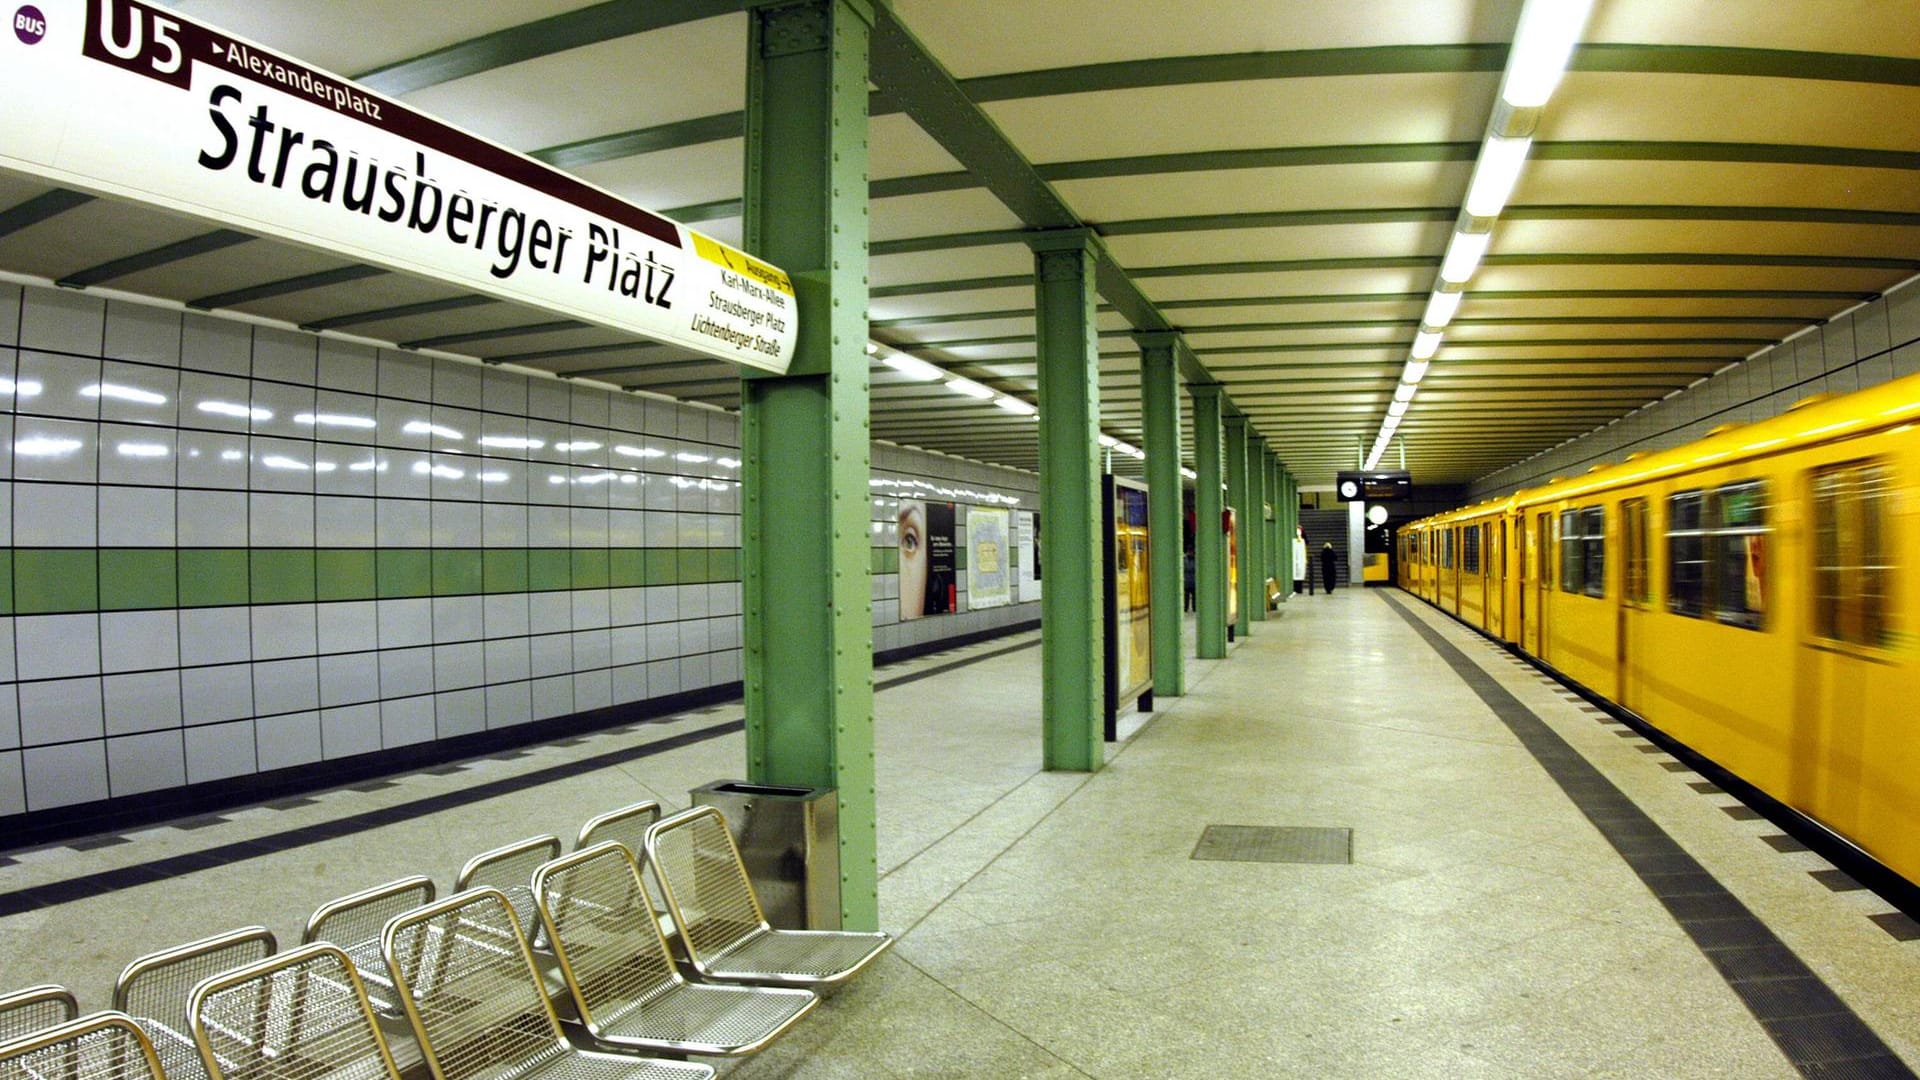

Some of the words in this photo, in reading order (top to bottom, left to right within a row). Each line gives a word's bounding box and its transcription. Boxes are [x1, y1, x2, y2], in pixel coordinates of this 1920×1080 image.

[15, 13, 46, 36] BUS
[100, 0, 183, 74] U5
[226, 42, 384, 121] Alexanderplatz
[197, 84, 573, 279] Strausberger
[583, 221, 676, 310] Platz
[720, 268, 786, 309] Karl-Marx-Allee
[709, 290, 765, 328] Strausberger
[765, 311, 786, 334] Platz
[690, 313, 754, 351] Lichtenberger
[752, 334, 781, 358] Straße
